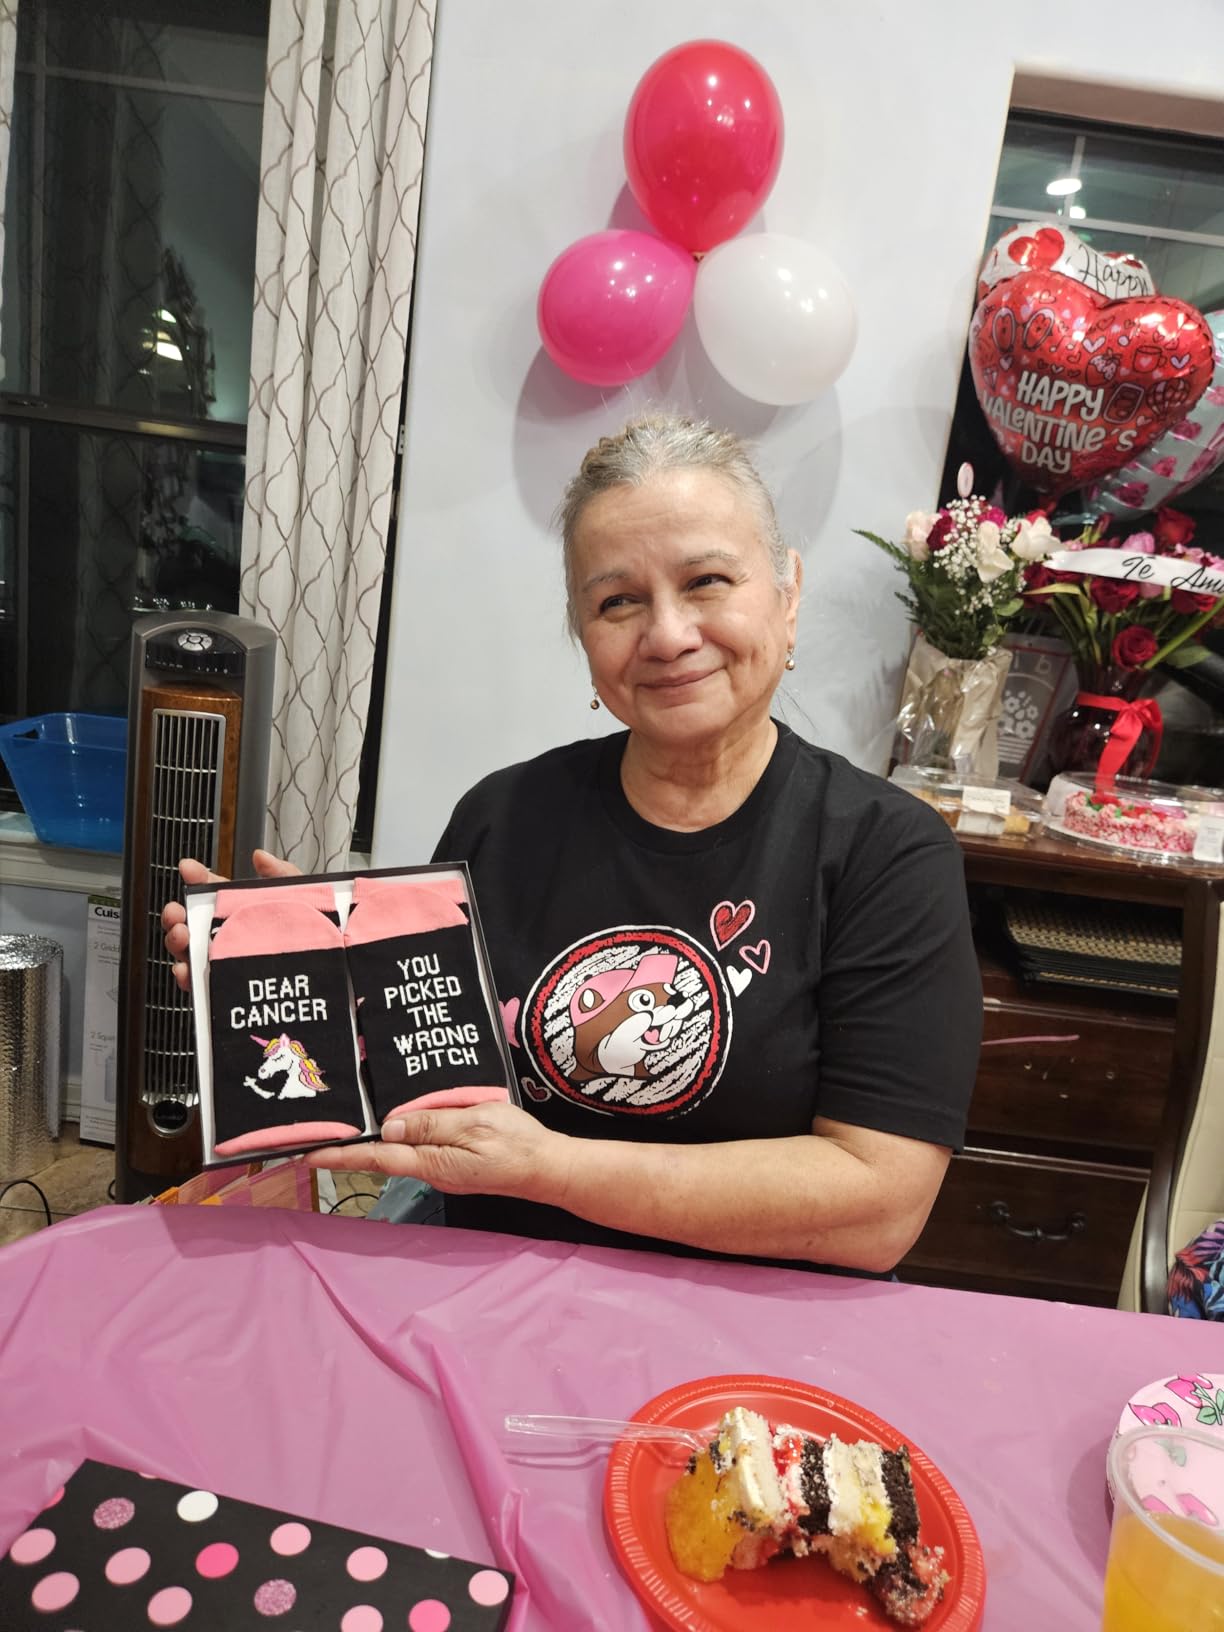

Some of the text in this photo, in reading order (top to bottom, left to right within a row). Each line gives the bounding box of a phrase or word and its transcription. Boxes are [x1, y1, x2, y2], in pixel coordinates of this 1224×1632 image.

[1016, 370, 1104, 421] HAPPY
[1020, 440, 1072, 473] DAY
[1122, 556, 1156, 579] Te
[396, 953, 441, 981] YOU
[248, 974, 310, 1002] DEAR
[383, 976, 462, 1010] PICKED
[230, 998, 328, 1030] CANCER
[406, 1001, 453, 1029] THE
[392, 1023, 480, 1056] WRONG
[405, 1047, 479, 1077] BITCH
